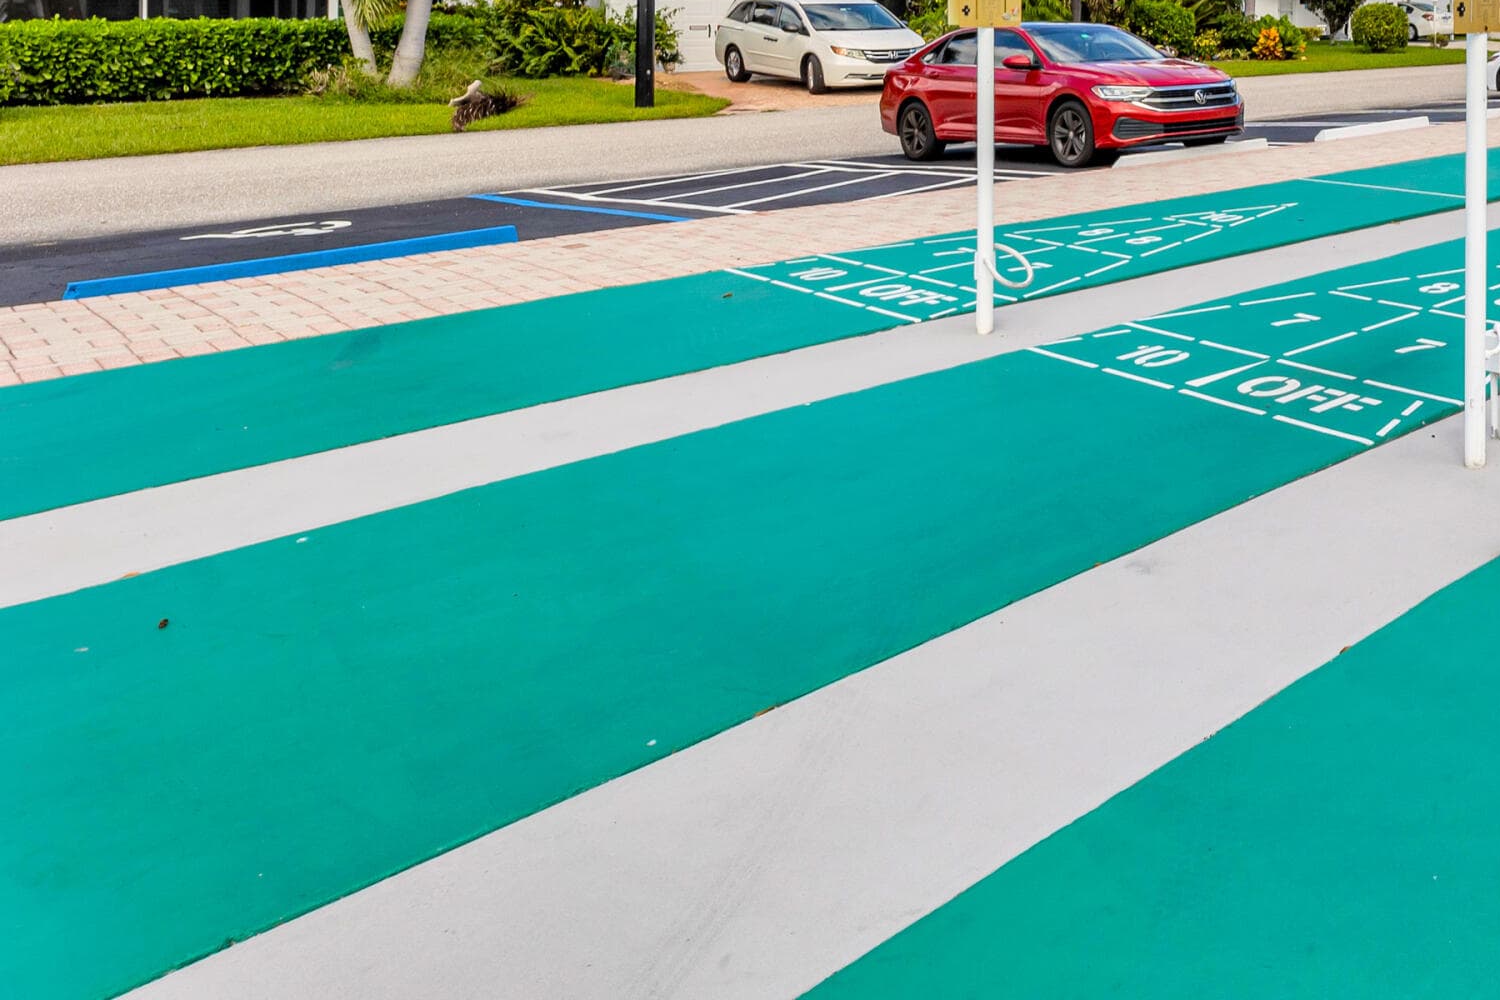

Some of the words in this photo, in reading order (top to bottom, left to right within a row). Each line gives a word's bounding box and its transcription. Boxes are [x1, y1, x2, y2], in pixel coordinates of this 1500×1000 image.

[1200, 213, 1243, 222] 10
[1078, 228, 1114, 236] 8
[1126, 236, 1162, 244] 8
[790, 267, 848, 281] 10
[859, 284, 957, 305] OFF
[1419, 282, 1460, 295] 8
[1272, 313, 1321, 326] 7
[1395, 338, 1447, 354] 7
[1116, 345, 1190, 368] 10
[1237, 376, 1382, 413] OFF
